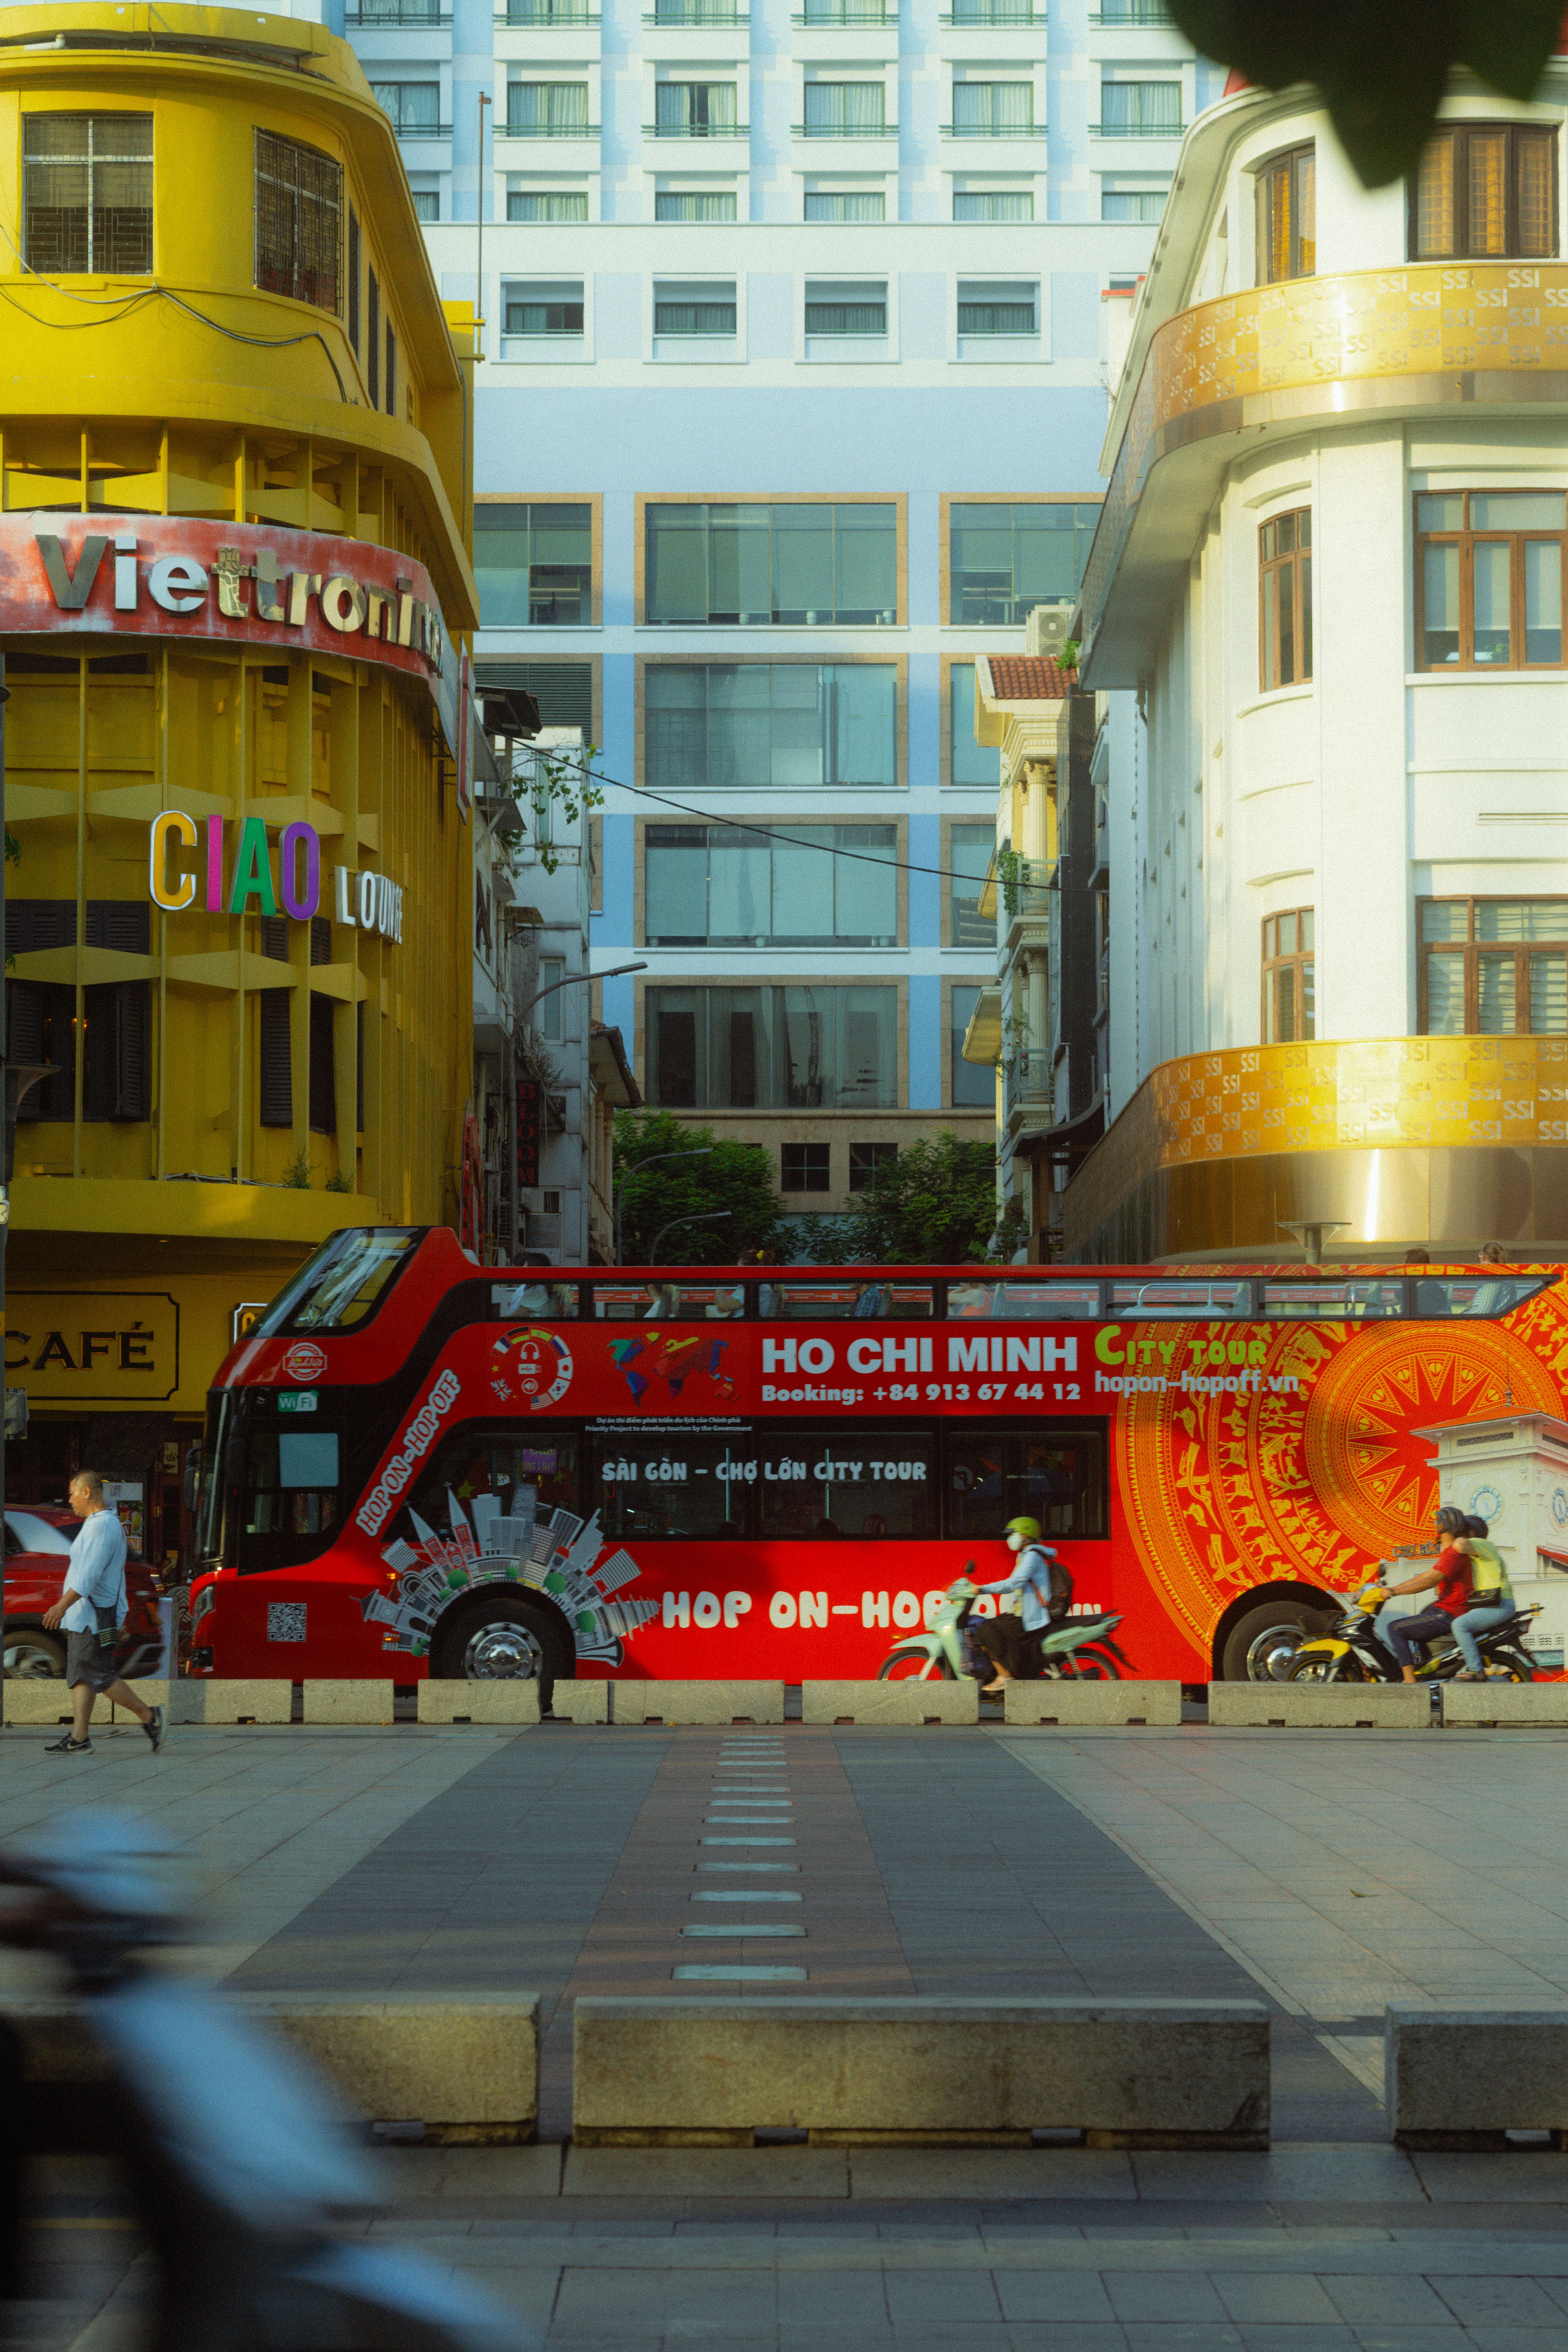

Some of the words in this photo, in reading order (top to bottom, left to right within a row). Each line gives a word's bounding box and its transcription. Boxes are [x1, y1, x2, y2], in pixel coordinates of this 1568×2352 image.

[1376, 273, 1407, 294] SSI
[1442, 270, 1474, 289] SSI
[1508, 269, 1539, 288] SSI
[1409, 291, 1440, 311] SSI
[1475, 289, 1508, 307] SSI
[1544, 289, 1568, 307] SS
[1237, 315, 1258, 336] SSI
[1443, 309, 1474, 327] SSI
[1508, 308, 1539, 327] SSI
[1410, 329, 1441, 348] SSI
[1476, 326, 1508, 345] SSI
[1545, 326, 1568, 345] SS
[1237, 352, 1258, 372] SSI
[1443, 346, 1474, 365] SSI
[1509, 345, 1540, 364] SSI
[149, 809, 320, 920] CIAO
[335, 865, 402, 945] LOUNGE
[1284, 1049, 1308, 1067] SSI
[1469, 1042, 1501, 1061] SSI
[1205, 1057, 1222, 1077] SSI
[1241, 1053, 1260, 1073] SSI
[1503, 1062, 1535, 1081] SSI
[1223, 1074, 1240, 1094] SSI
[1469, 1082, 1501, 1100] SSI
[1241, 1091, 1260, 1111] SSI
[1436, 1101, 1468, 1120] SSI
[1503, 1100, 1534, 1119] SSI
[1223, 1112, 1240, 1131] SSI
[1263, 1108, 1285, 1127] SSI
[517, 1084, 536, 1184] BLOOM
[1286, 1126, 1309, 1145] SSI
[1469, 1120, 1501, 1139] SSI
[1206, 1133, 1222, 1152] SSI
[5, 1322, 154, 1371] CAFÉ
[762, 1338, 835, 1374] HO
[847, 1337, 933, 1374] CHI
[948, 1336, 1078, 1372] MINH
[1188, 1340, 1267, 1365] TOUR
[1095, 1369, 1298, 1398] hopon-hopoff.vn
[762, 1384, 864, 1405] Booking:
[873, 1383, 919, 1401] +84
[926, 1383, 970, 1401] 913
[977, 1383, 1007, 1400] 67
[1014, 1383, 1044, 1400] 44
[1053, 1383, 1080, 1400] 12
[358, 1487, 391, 1534] HOP
[430, 1371, 459, 1412] OFF
[602, 1458, 637, 1481] SÀI
[645, 1458, 687, 1481] GÒN
[716, 1459, 757, 1485] CHỢ
[765, 1457, 806, 1481] LỚN
[814, 1461, 864, 1481] CITY
[870, 1461, 926, 1481] TOUR
[662, 1591, 752, 1628] HOP
